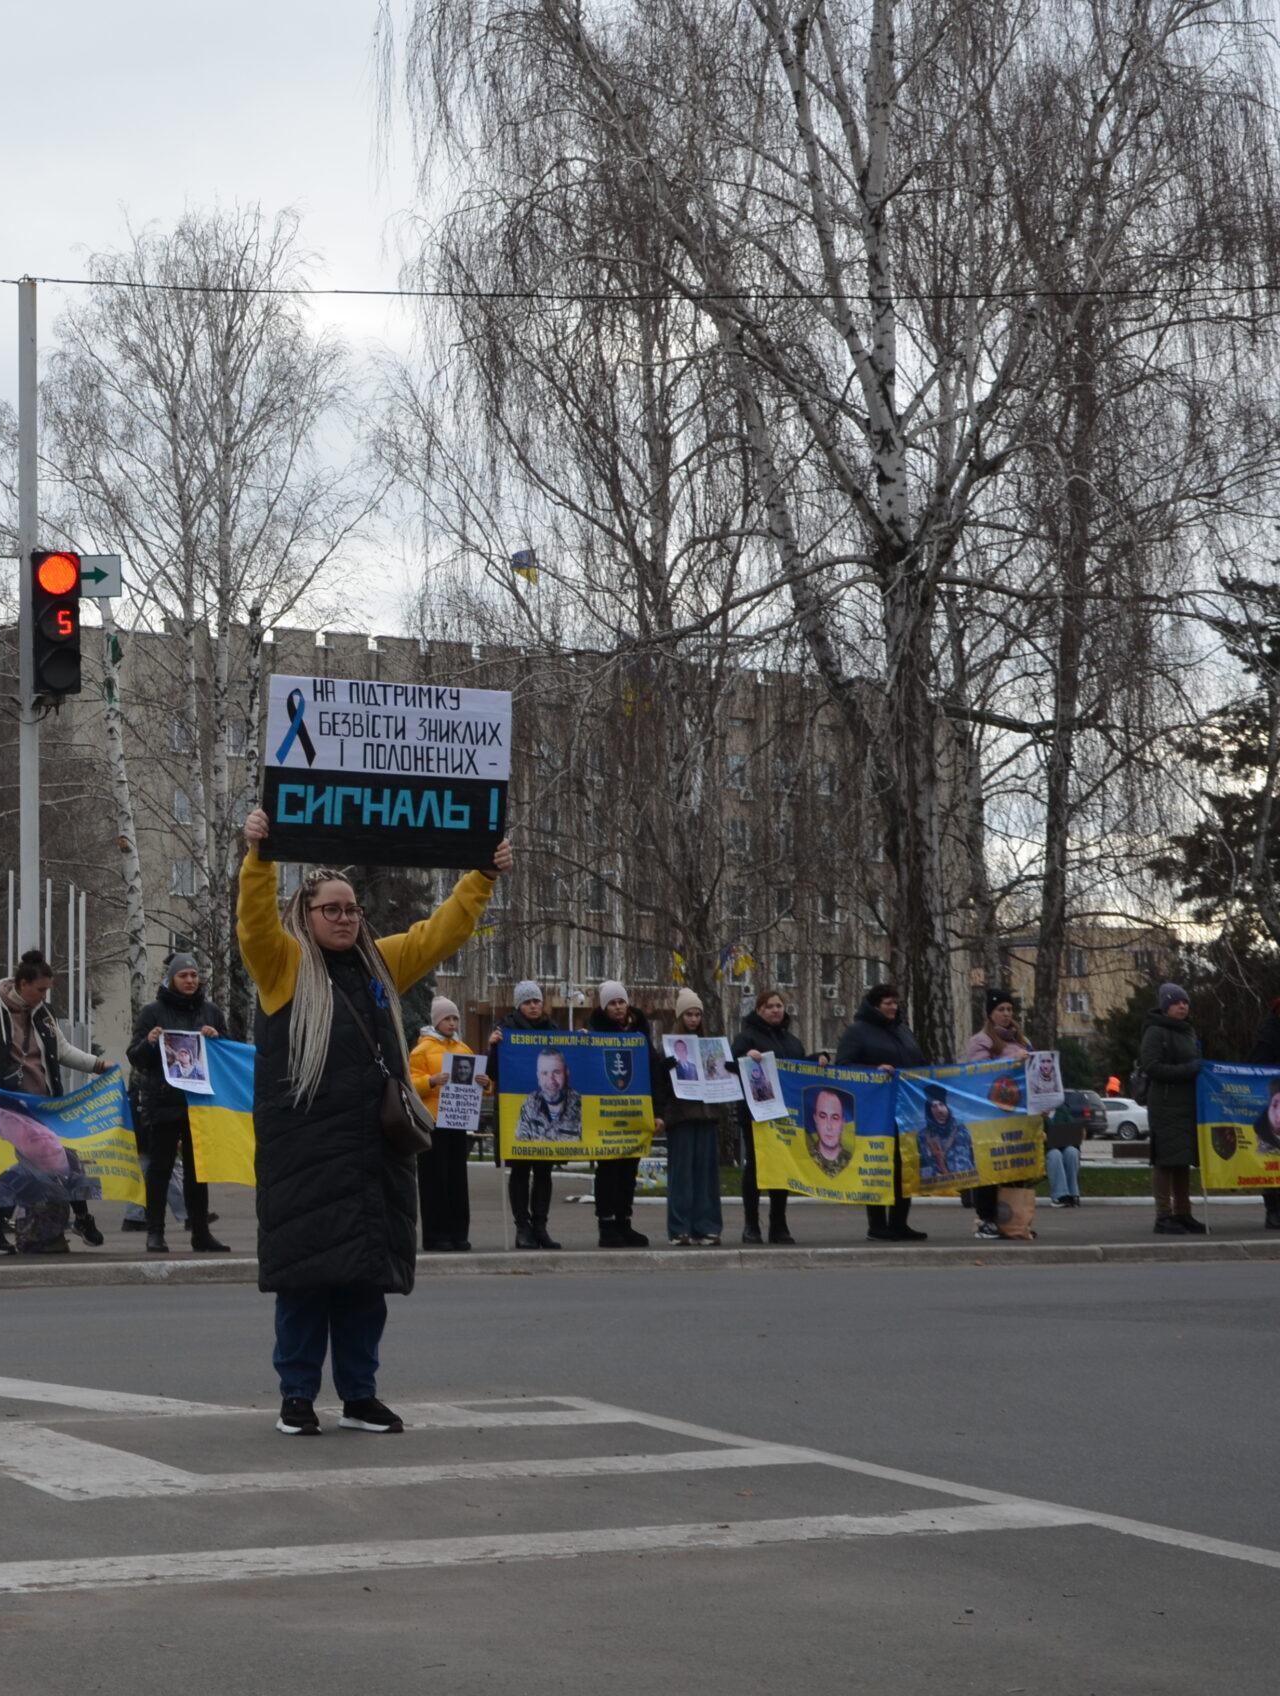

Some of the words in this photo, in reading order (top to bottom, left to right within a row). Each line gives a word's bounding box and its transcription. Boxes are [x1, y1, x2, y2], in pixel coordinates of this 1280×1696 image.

[58, 610, 72, 635] 5
[313, 679, 336, 703] НА
[349, 682, 461, 711] ПІДТРИМКУ
[319, 711, 406, 740] БЕЗВІСТИ
[417, 716, 502, 747] ЗНИКЛИХ
[363, 743, 479, 775] ПОЛОНЕНИХ
[277, 783, 470, 830] СИГНАЛЬ
[511, 1035, 548, 1046] БЕЗВІСТИ
[591, 1037, 620, 1047] ЗНАЧИТЬ
[439, 1107, 478, 1115] ЗНАЙДІТЬ
[512, 1146, 554, 1156] ПОВЕРНІТЬ
